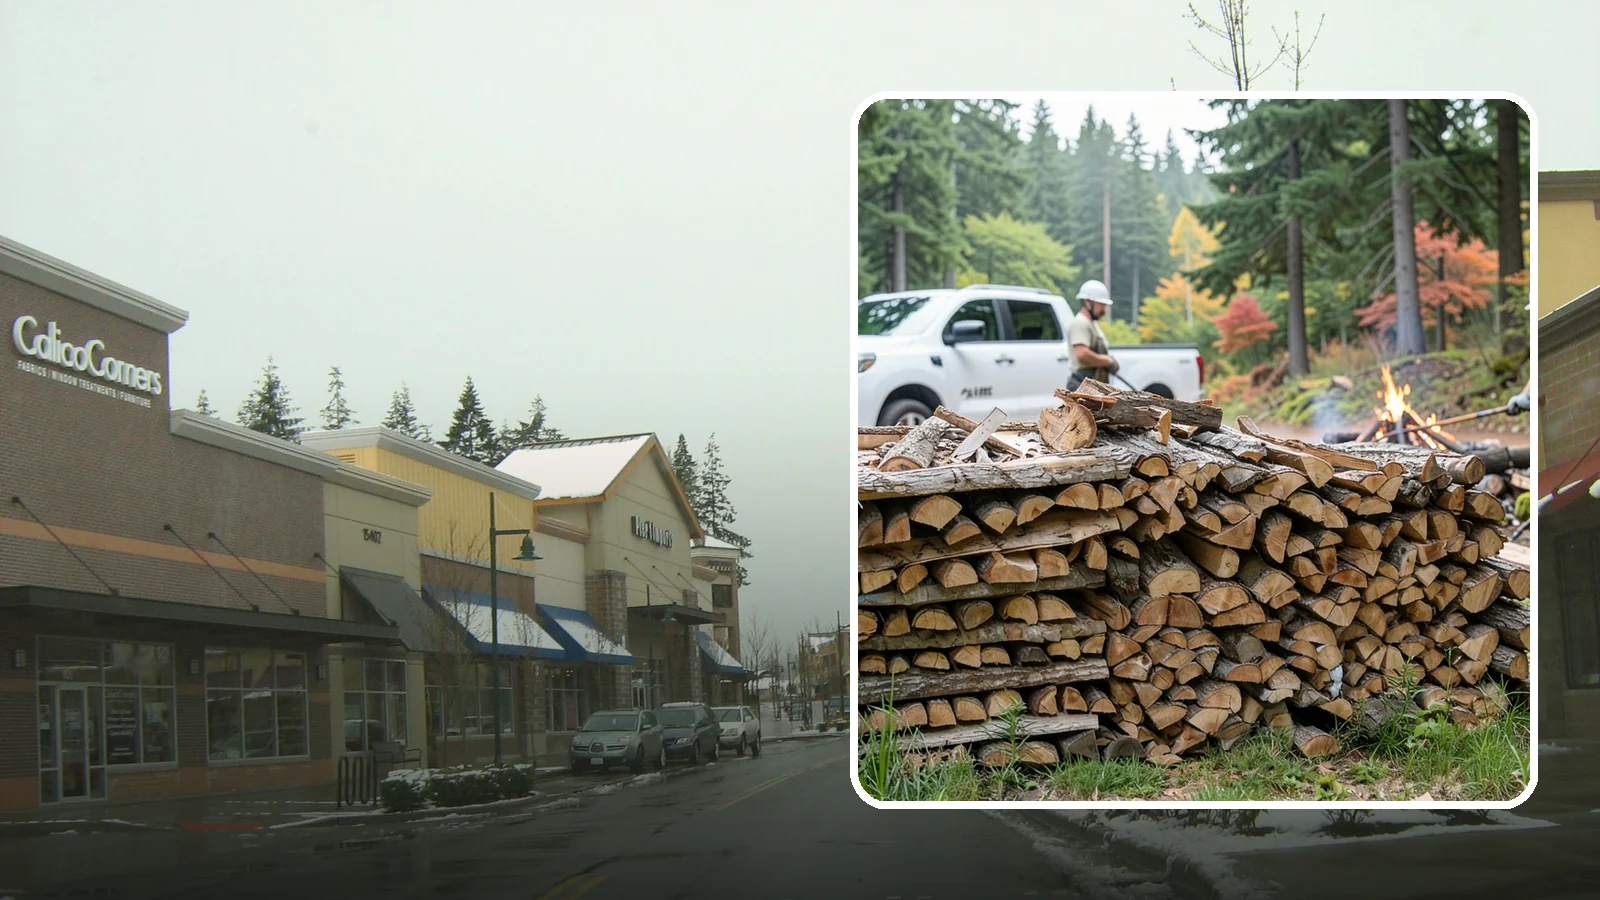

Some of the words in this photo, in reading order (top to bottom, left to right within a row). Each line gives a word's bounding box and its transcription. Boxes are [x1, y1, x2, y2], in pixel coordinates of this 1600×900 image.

[16, 360, 47, 377] FABRICS
[51, 370, 78, 386] WINDOW
[79, 379, 116, 398] TREATMENTS
